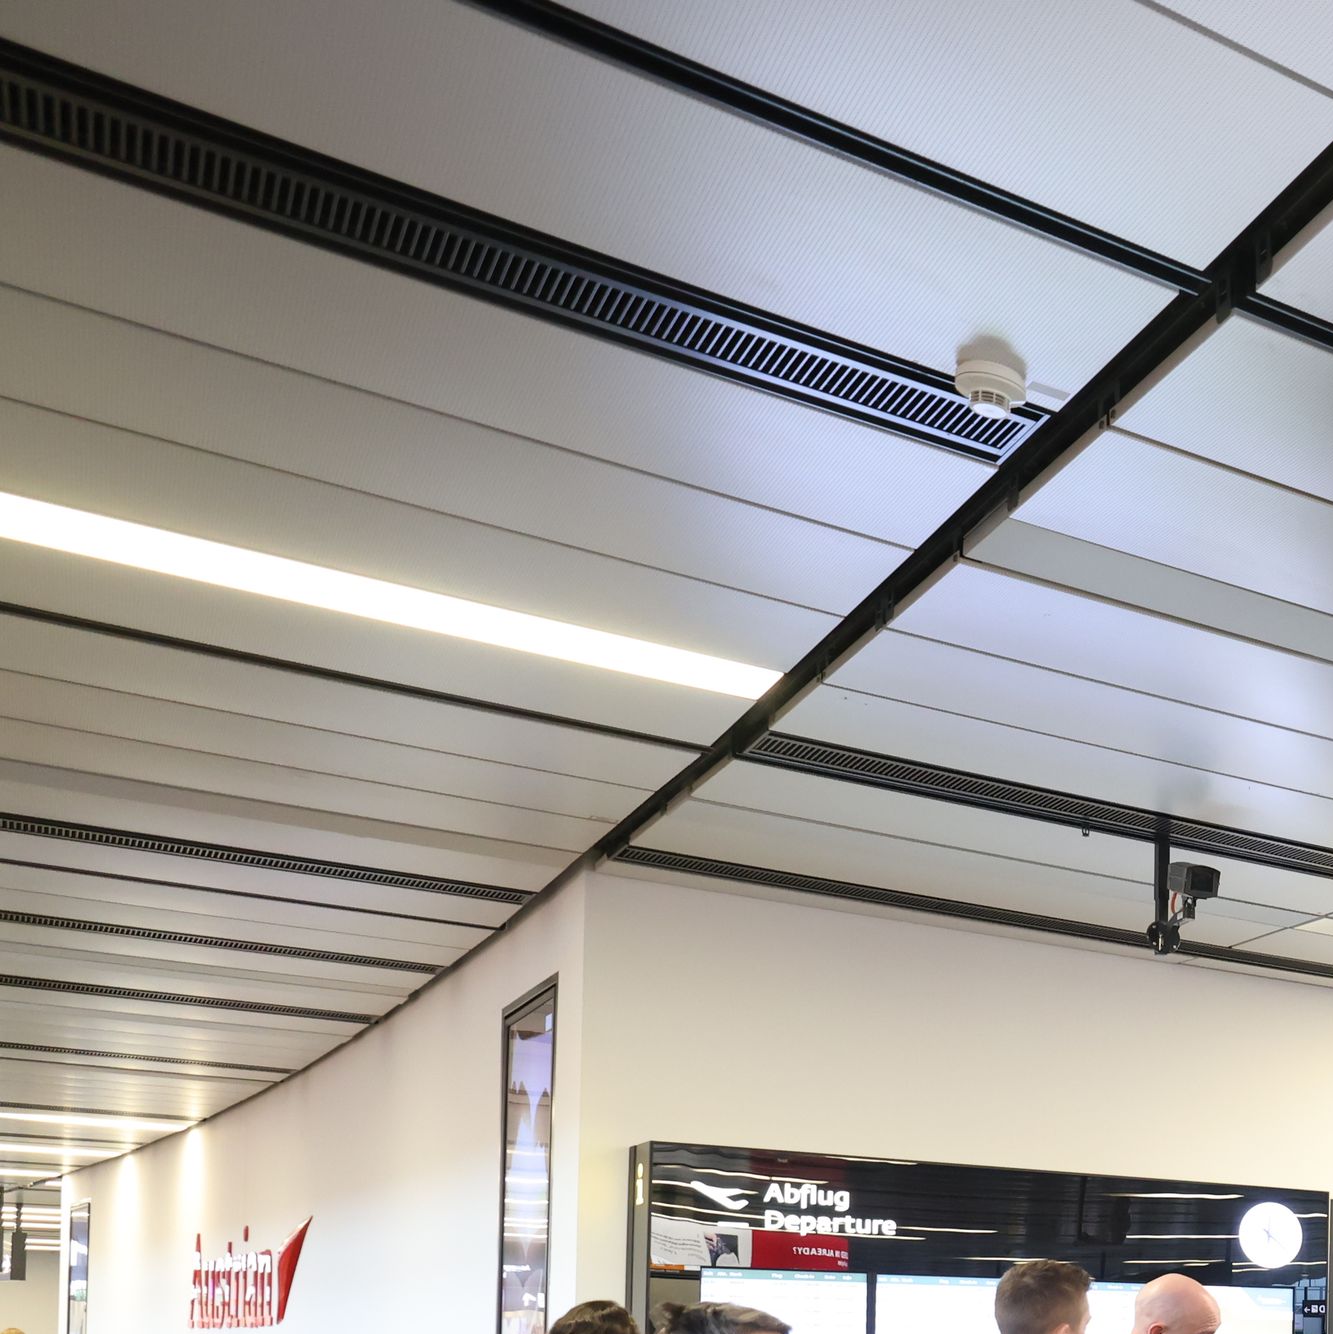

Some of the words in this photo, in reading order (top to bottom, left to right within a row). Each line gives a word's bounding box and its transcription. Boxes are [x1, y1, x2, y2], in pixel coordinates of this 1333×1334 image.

[763, 1183, 851, 1211] Abflug
[763, 1210, 897, 1236] Departure
[188, 1225, 273, 1328] Austrian
